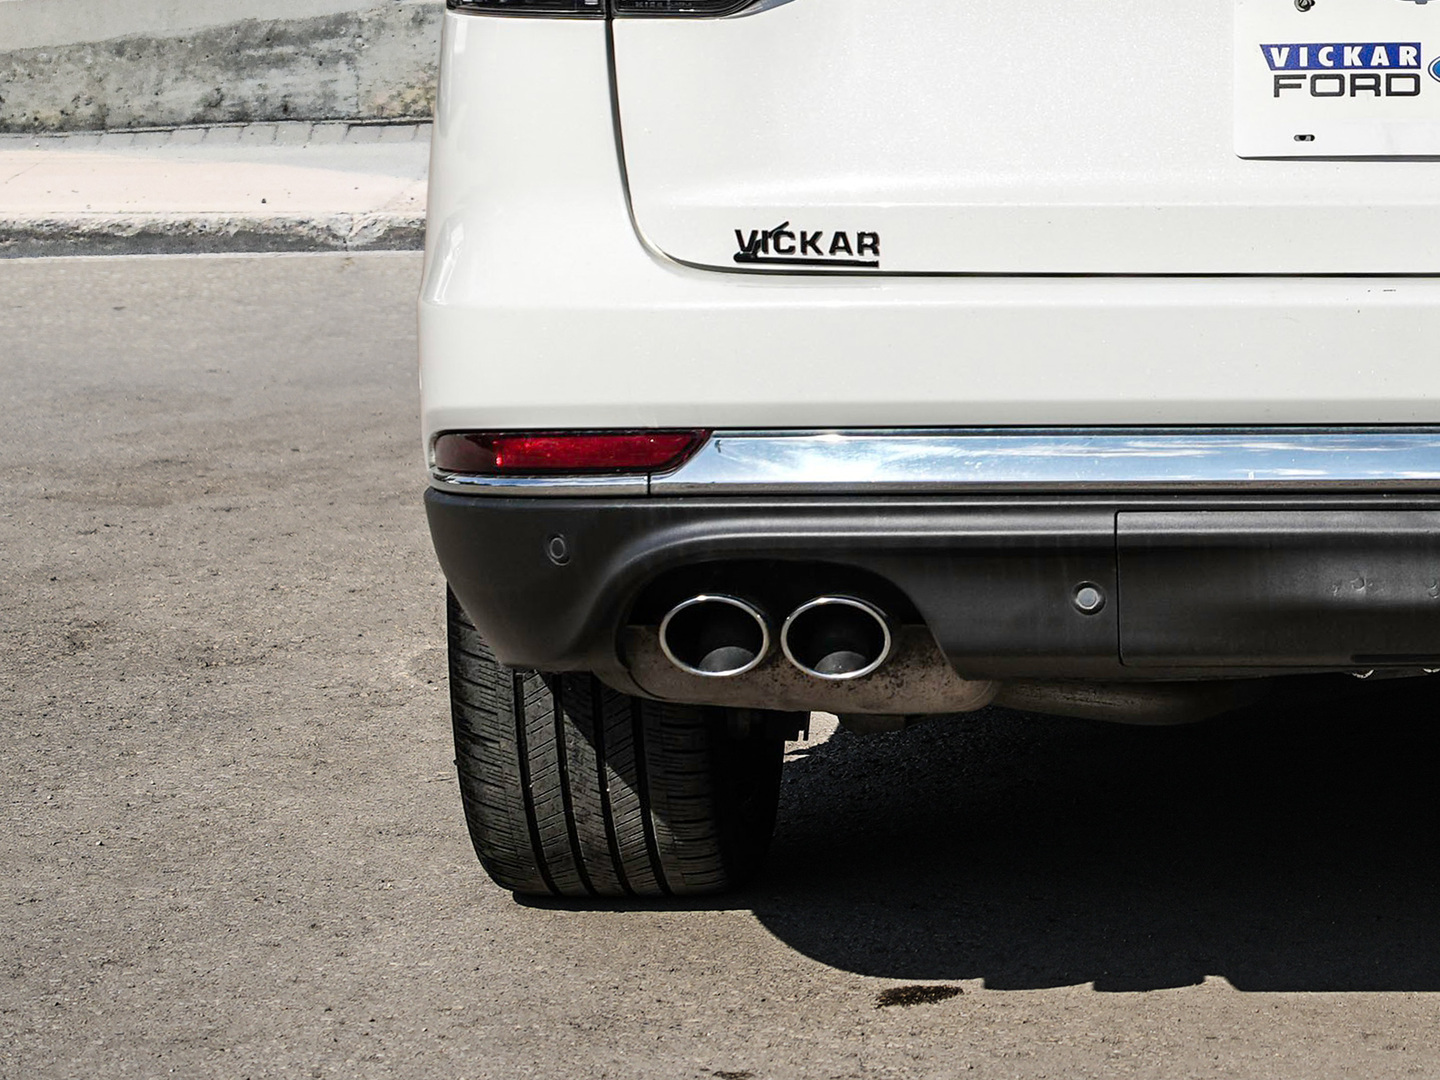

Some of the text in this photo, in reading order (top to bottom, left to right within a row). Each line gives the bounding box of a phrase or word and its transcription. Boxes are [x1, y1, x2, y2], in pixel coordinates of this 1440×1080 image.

[1268, 44, 1420, 69] VICKAR
[1273, 73, 1421, 98] FORD
[734, 227, 881, 256] VICKAR
